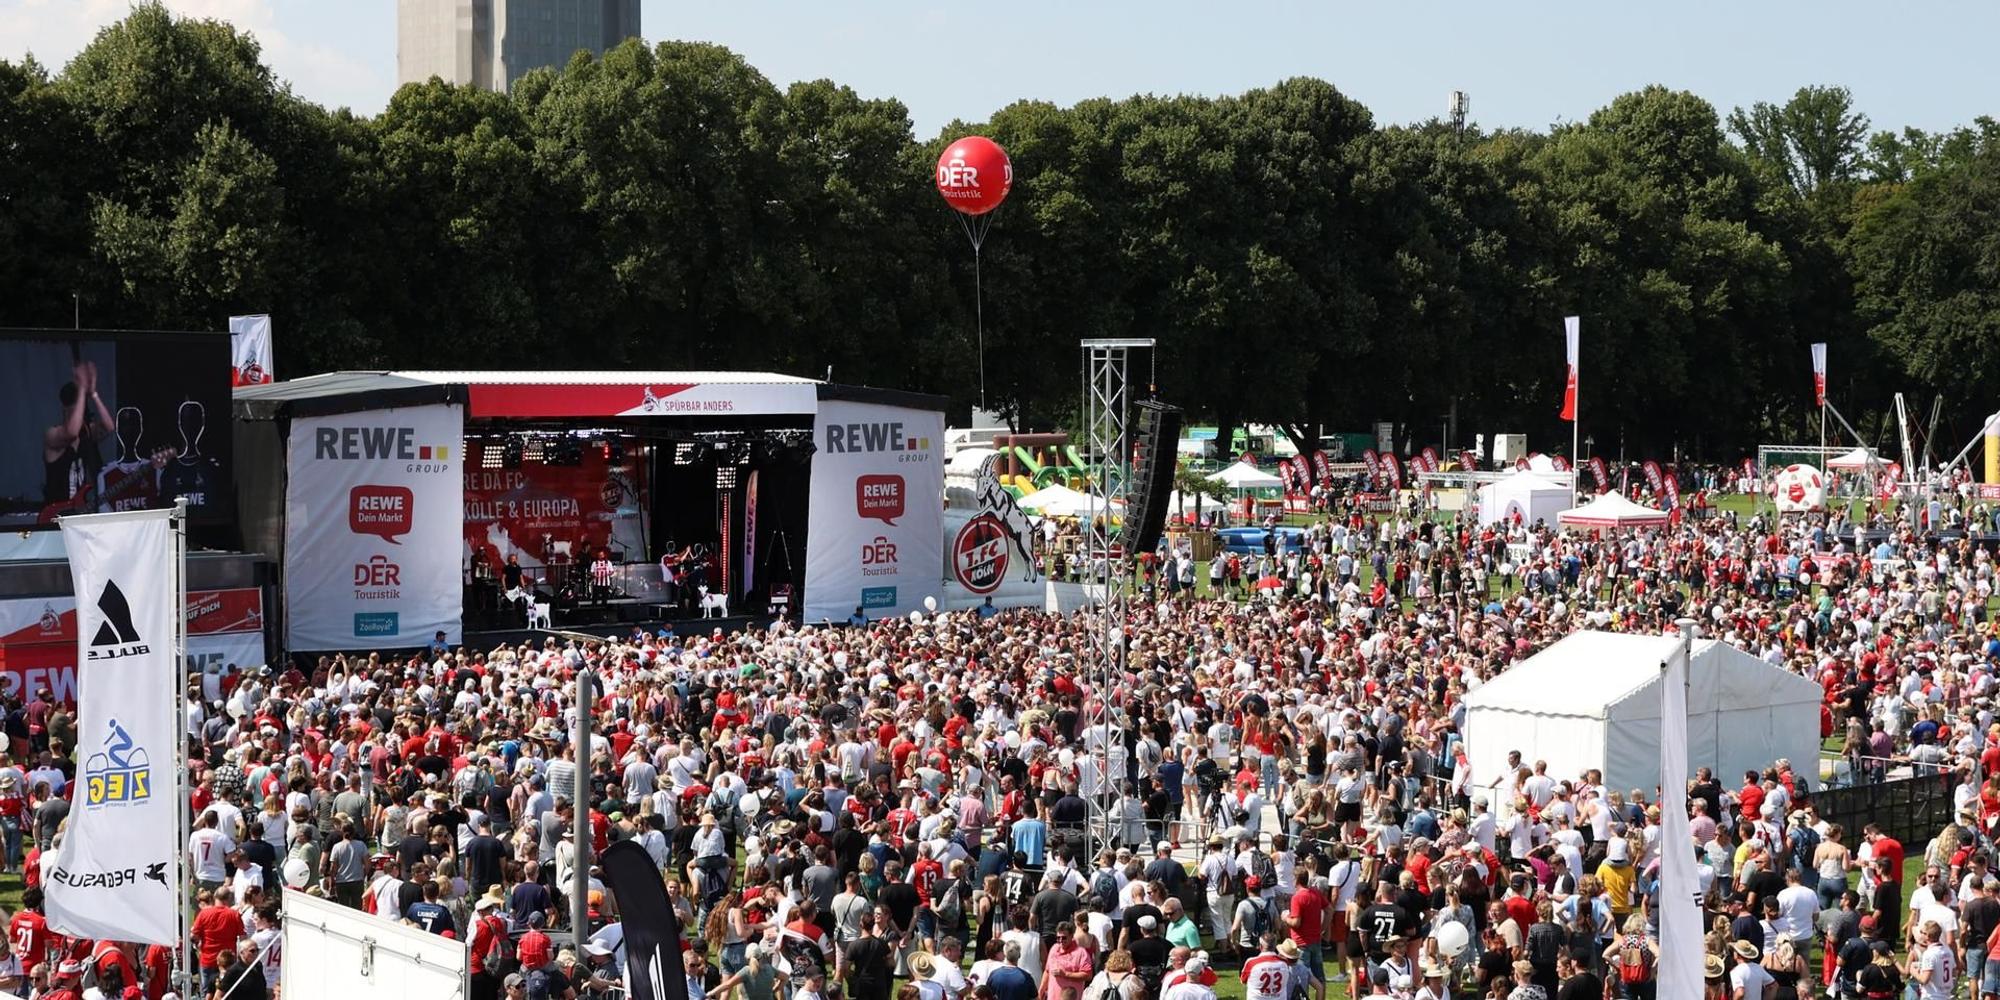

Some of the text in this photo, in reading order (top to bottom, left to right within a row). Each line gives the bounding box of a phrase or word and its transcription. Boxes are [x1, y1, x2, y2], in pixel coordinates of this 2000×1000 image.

[939, 166, 979, 187] DER
[315, 427, 415, 460] REWE
[826, 423, 904, 454] REWE
[406, 464, 449, 473] GROUP
[898, 454, 929, 463] GROUP
[483, 469, 500, 490] DÄ
[506, 472, 524, 489] FC
[863, 483, 898, 498] REWE
[359, 496, 404, 510] REWE
[509, 502, 518, 518] &
[523, 499, 579, 517] EUROPA
[863, 498, 898, 508] Dein Markt
[358, 513, 403, 522] Dein Markt
[862, 543, 898, 564] DER
[354, 564, 401, 586] DER
[862, 567, 897, 576] Touristik
[971, 563, 995, 583] KÖLN
[354, 589, 400, 599] Touristik
[201, 842, 211, 861] 7
[1005, 877, 1022, 899] 14
[422, 917, 433, 932] 7
[1374, 917, 1395, 939] 27
[17, 927, 33, 952] 21
[267, 945, 281, 967] 14
[1943, 960, 1950, 983] 5
[1260, 972, 1282, 993] 23
